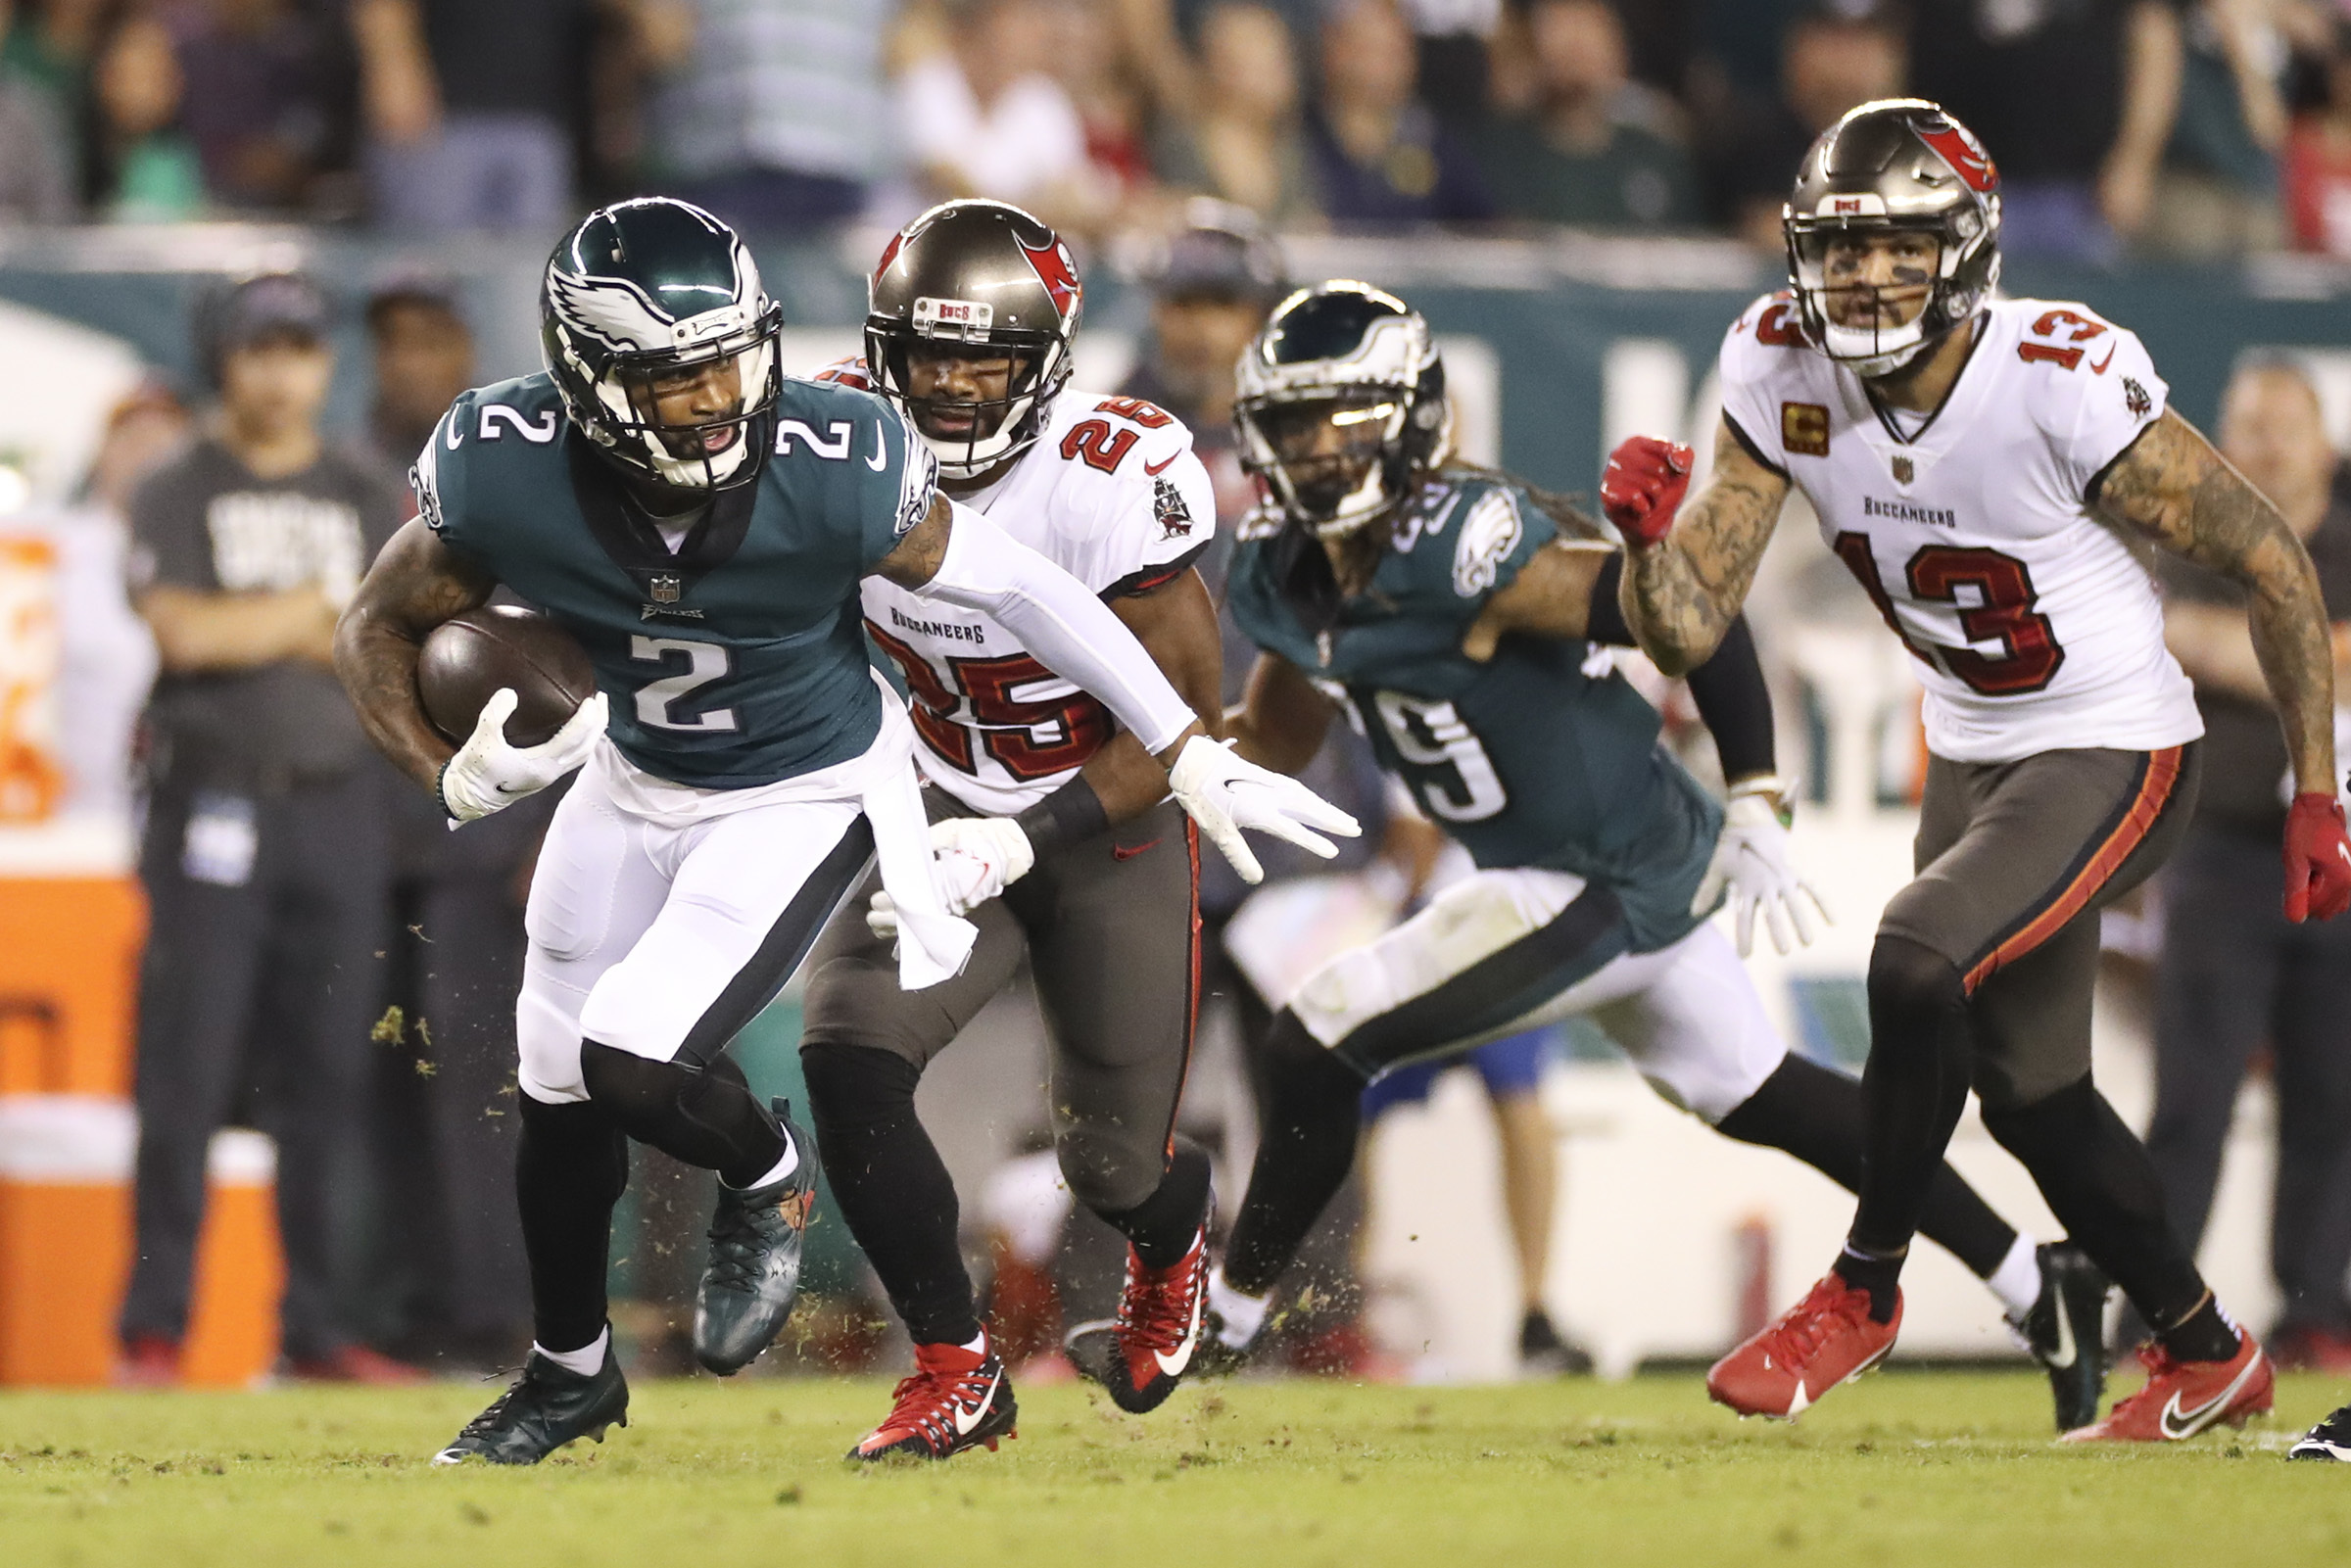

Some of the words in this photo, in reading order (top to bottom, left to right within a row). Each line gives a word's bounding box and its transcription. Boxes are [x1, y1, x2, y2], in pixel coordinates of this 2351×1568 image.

[2017, 309, 2108, 371] 13
[478, 403, 557, 444] 2
[774, 417, 855, 461] 2
[1059, 396, 1174, 475] 25
[1863, 495, 1956, 528] BUCCANEERS
[889, 605, 984, 644] BUCCANEERS
[1833, 530, 2066, 696] 13
[630, 634, 740, 732] 2
[861, 616, 1117, 784] 25
